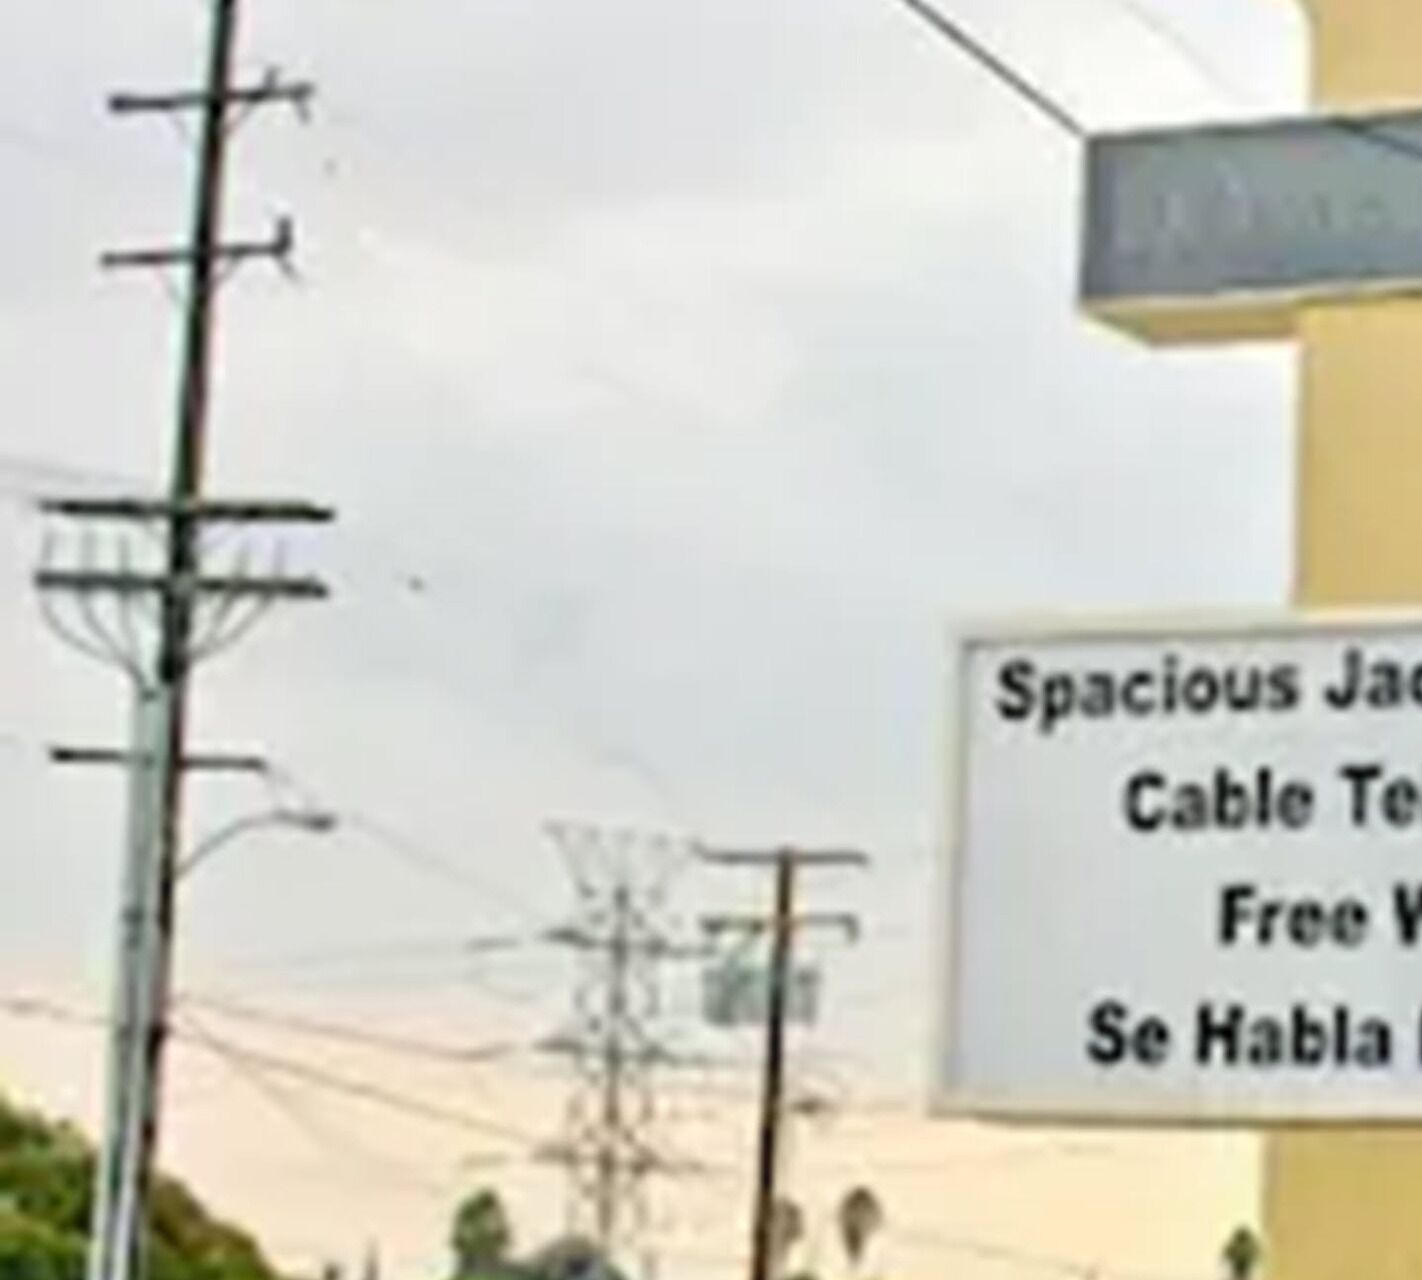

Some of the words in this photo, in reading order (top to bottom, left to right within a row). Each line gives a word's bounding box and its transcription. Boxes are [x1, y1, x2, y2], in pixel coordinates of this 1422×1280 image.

[996, 658, 1301, 733] Spacious
[1124, 766, 1316, 833] Cable
[1218, 883, 1369, 947] Free
[1086, 1000, 1171, 1067] Se
[1194, 1003, 1393, 1068] Habla
